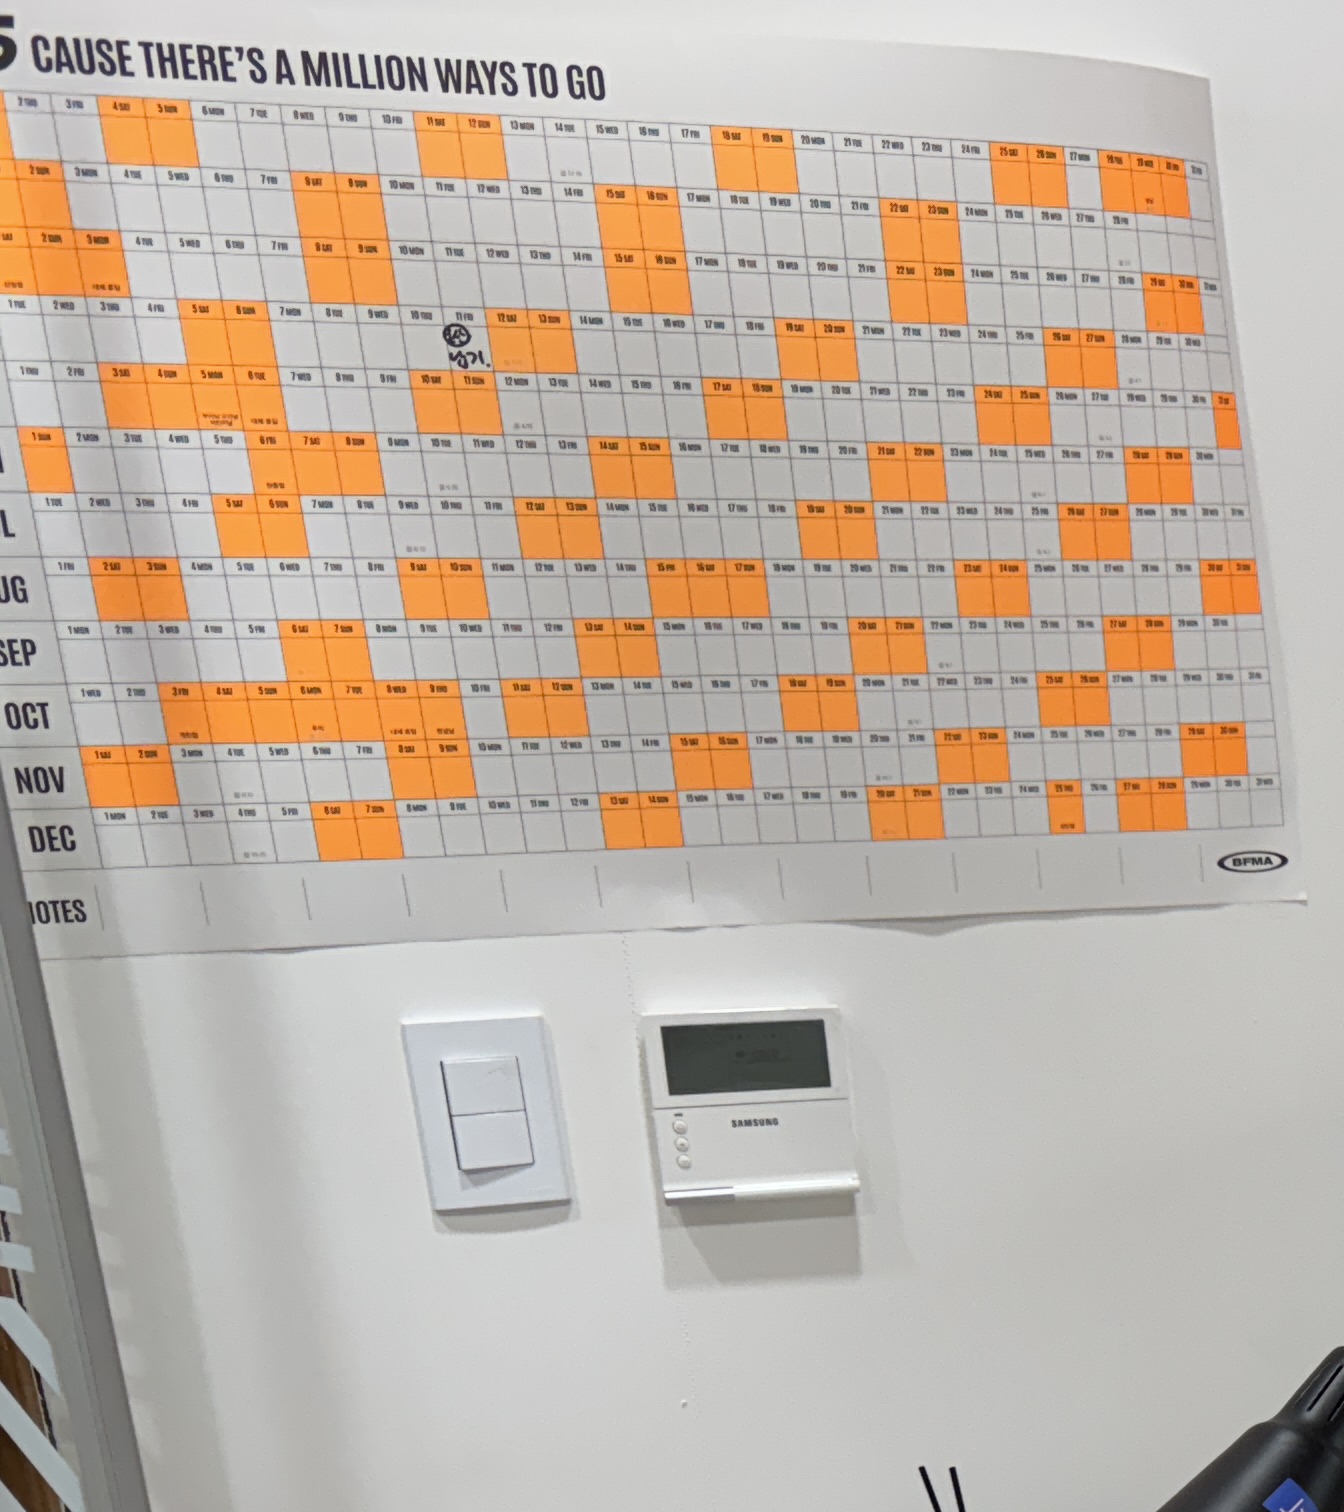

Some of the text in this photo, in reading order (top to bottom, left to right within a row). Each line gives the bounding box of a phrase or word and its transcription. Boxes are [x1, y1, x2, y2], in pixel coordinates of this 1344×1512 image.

[30, 35, 136, 78] CAUSE
[276, 49, 295, 85] A
[302, 50, 428, 92] MILLION
[436, 58, 518, 98] WAYS
[522, 63, 559, 100] TO
[567, 64, 606, 100] GO
[0, 638, 36, 667] SEP
[5, 702, 50, 730] OCT
[14, 766, 64, 794] NOV
[28, 826, 76, 854] DEC
[1232, 853, 1272, 870] BFMA
[731, 1117, 778, 1128] SAMSUNG
